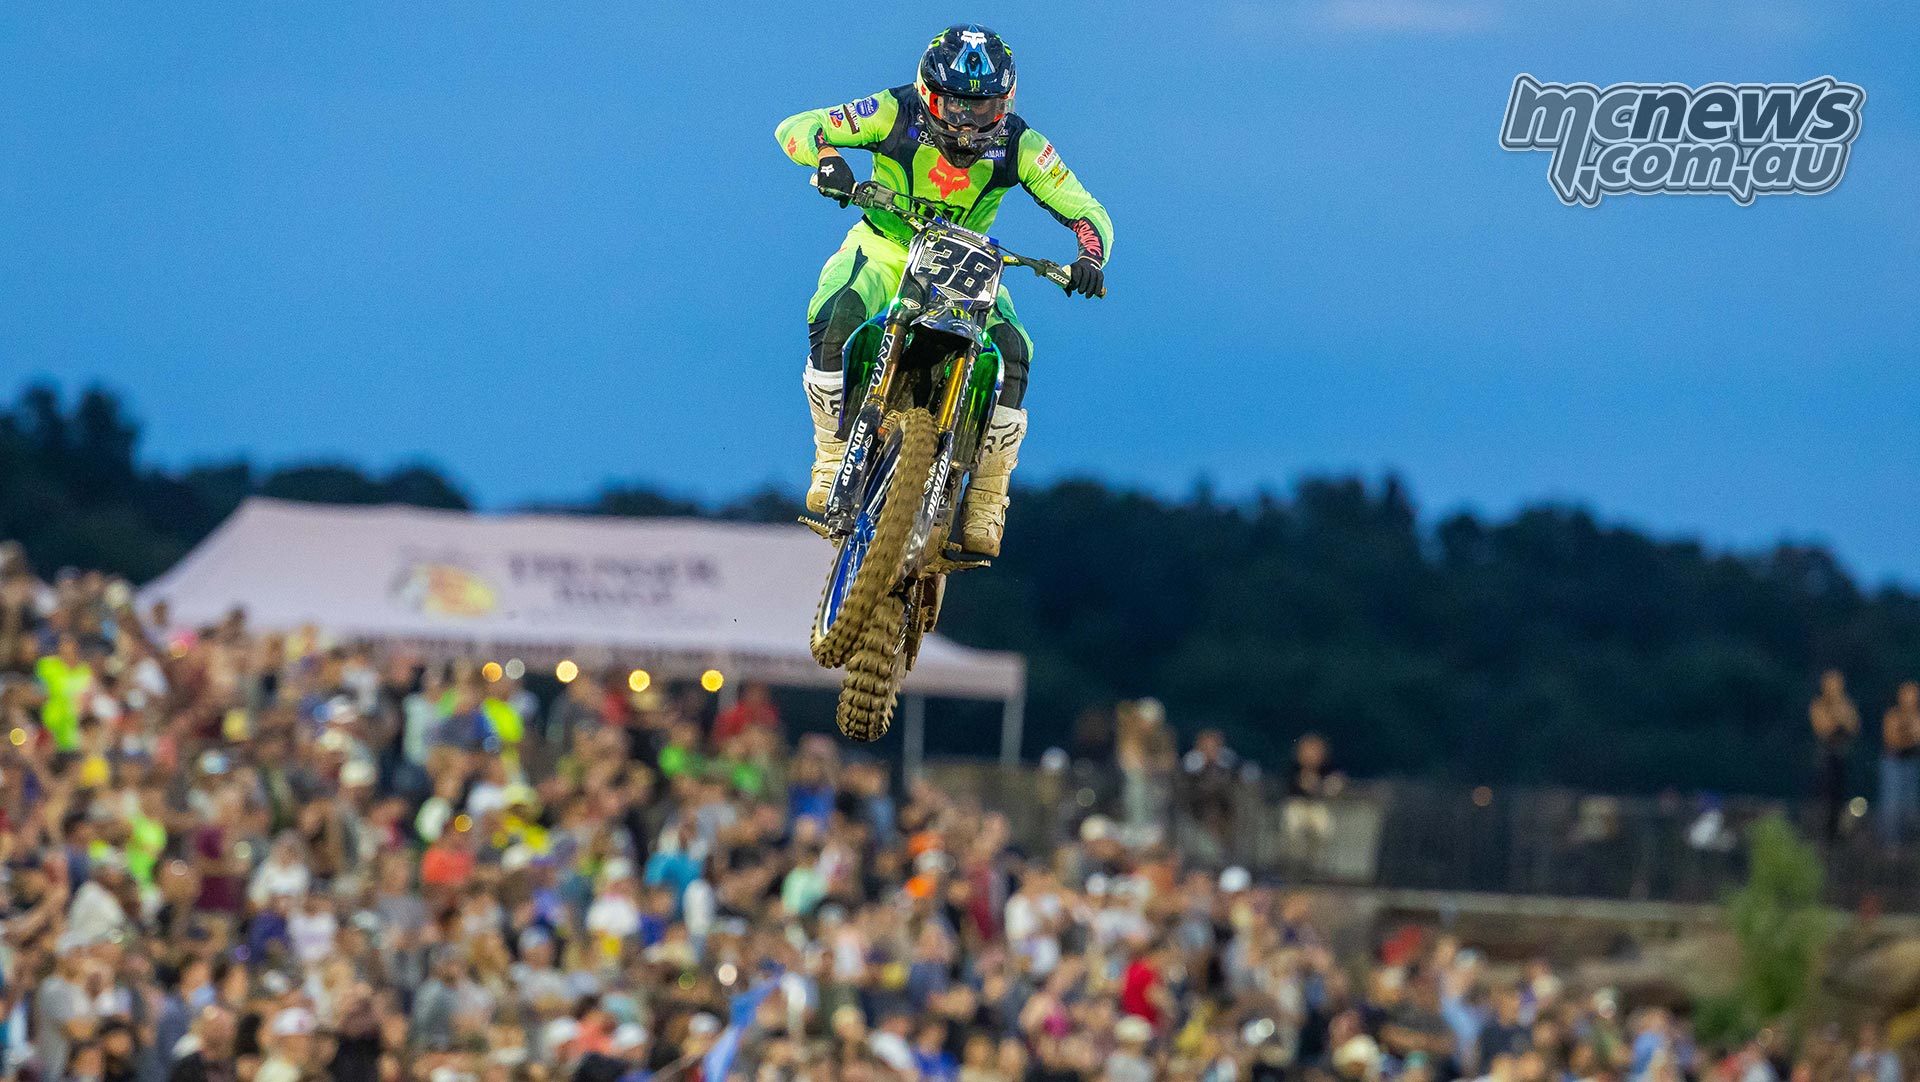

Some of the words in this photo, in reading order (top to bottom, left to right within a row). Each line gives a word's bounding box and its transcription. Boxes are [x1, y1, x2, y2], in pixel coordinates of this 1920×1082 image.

[917, 236, 999, 301] 38
[841, 420, 868, 487] DUNLOP
[927, 451, 949, 519] DUNLOP
